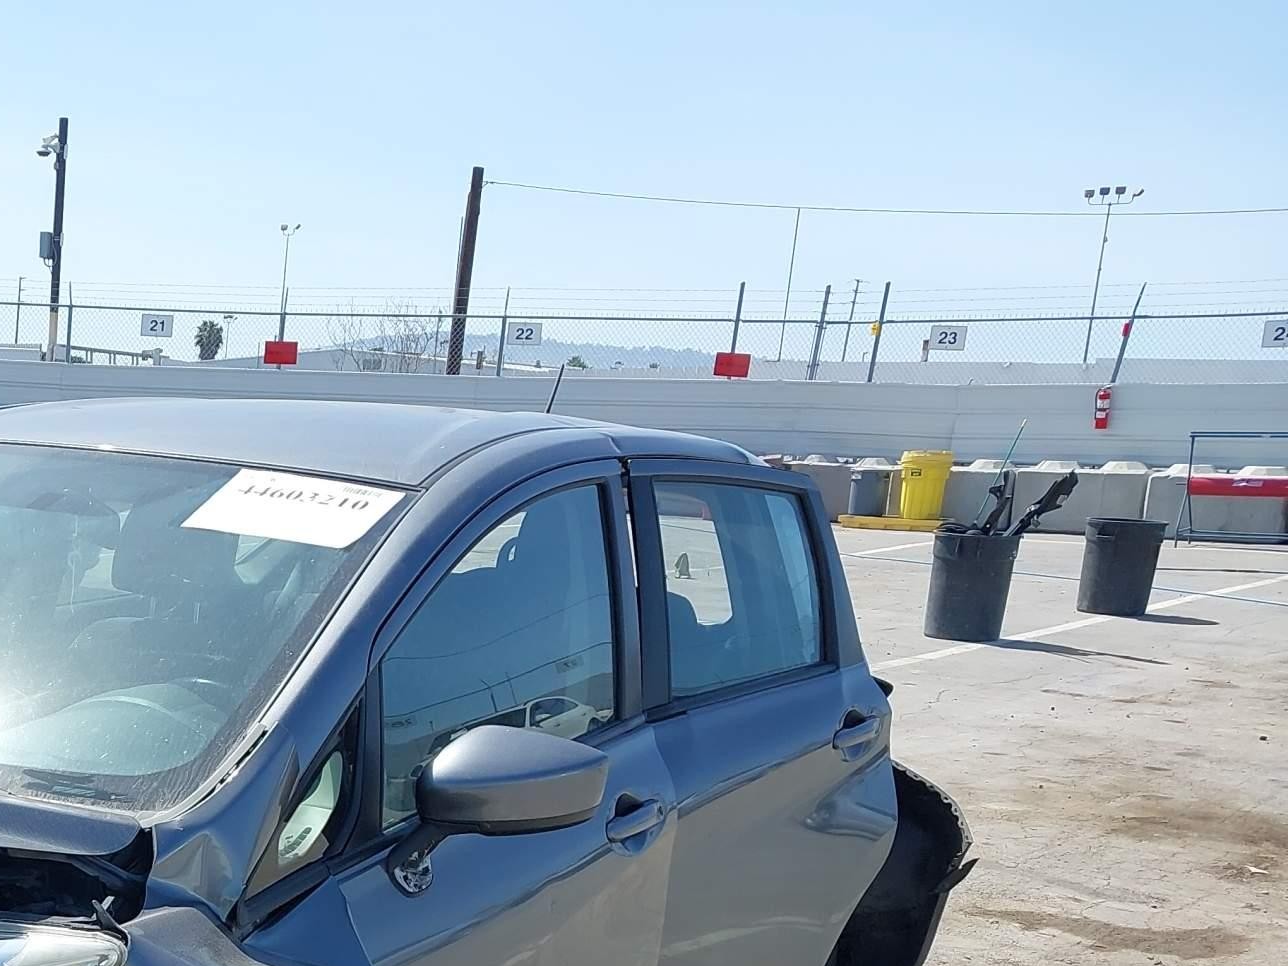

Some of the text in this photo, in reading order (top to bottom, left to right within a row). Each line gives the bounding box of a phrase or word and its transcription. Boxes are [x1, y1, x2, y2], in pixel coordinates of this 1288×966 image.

[150, 319, 165, 332] 21
[515, 327, 534, 340] 22
[937, 331, 958, 345] 23
[1272, 326, 1288, 341] 2
[238, 485, 370, 511] 44603210
